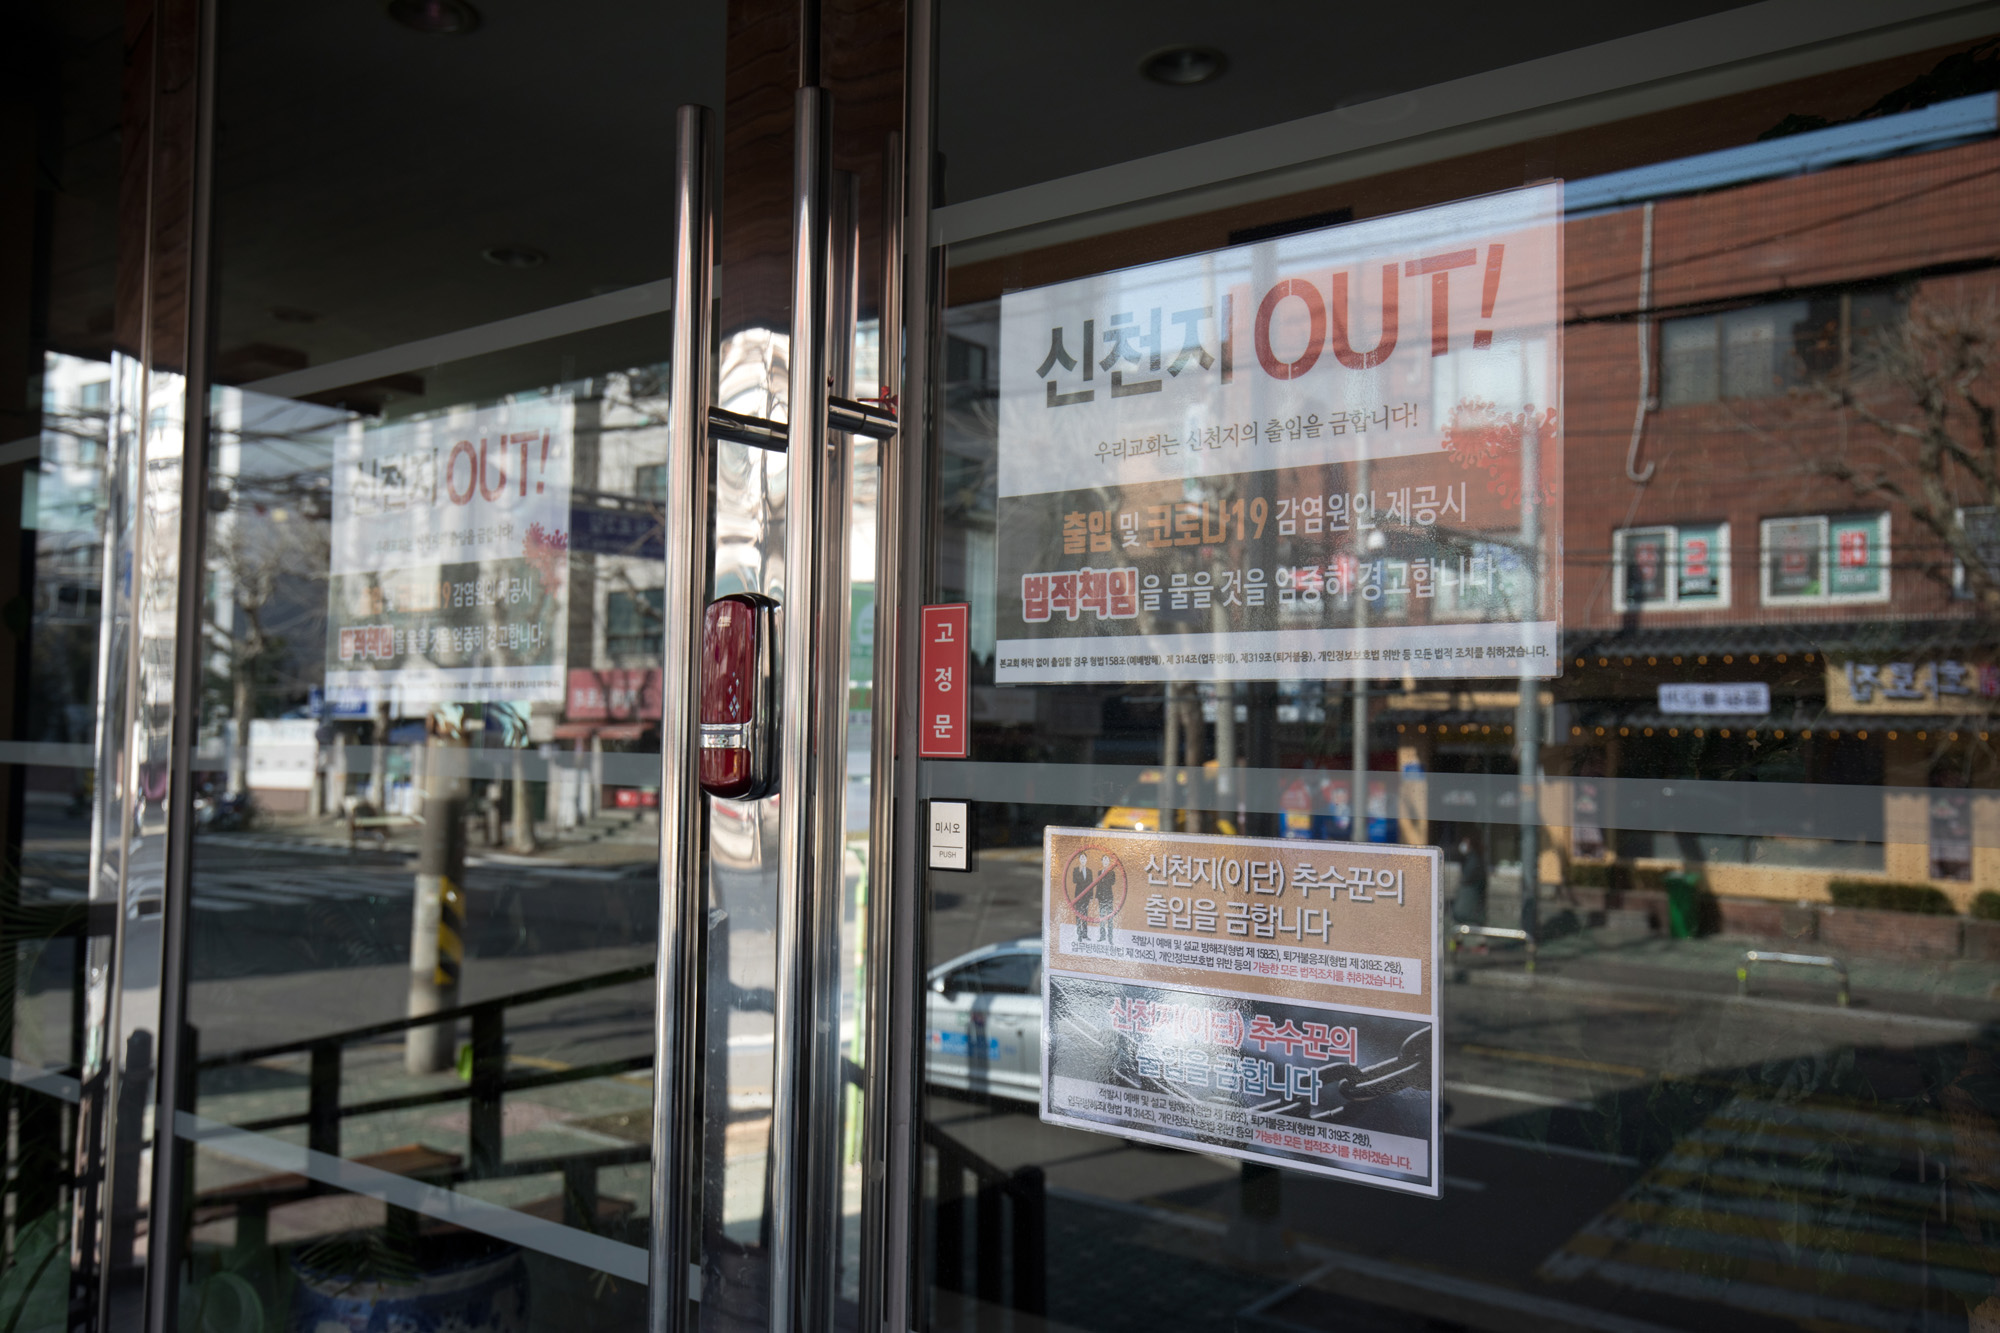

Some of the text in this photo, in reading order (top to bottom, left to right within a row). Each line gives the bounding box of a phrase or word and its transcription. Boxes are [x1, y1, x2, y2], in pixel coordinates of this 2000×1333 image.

[1036, 243, 1505, 408] 신천지 OUT!
[1094, 403, 1418, 464] 우리교회는 신천지의 출입을 금합니다!
[447, 428, 550, 506] OUT!
[1063, 482, 1466, 554] 출입 및 코로나19 감염원인 제공시
[1022, 567, 1162, 623] 법적책임을
[1168, 571, 1214, 610] 물을
[1221, 568, 1267, 607] 것을
[1275, 562, 1348, 605] 엄중히
[934, 622, 955, 739] 고정문
[1074, 656, 1088, 667] 경우
[1166, 654, 1174, 665] 제
[1382, 649, 1400, 661] 위반
[1402, 648, 1411, 660] 등
[1434, 647, 1453, 660] 법적
[935, 821, 960, 834] 미시오
[939, 850, 957, 859] PUSH
[1143, 854, 1405, 904] 신천지(이단) 추수꾼의
[1143, 894, 1332, 943] 출입을 금합니다
[1131, 935, 1155, 947] 적발시
[1156, 937, 1172, 949] 예배
[1173, 939, 1182, 950] 및
[1183, 940, 1199, 951] 설교
[1246, 947, 1255, 958] 제
[1349, 957, 1359, 970] 제
[1159, 951, 1214, 968] 개인정보보호법
[1216, 957, 1233, 970] 위반
[1234, 959, 1251, 972] 등의
[1253, 961, 1279, 975] 가능한
[1280, 964, 1298, 977] 모든
[1300, 967, 1344, 983] 법적조치를
[1346, 971, 1405, 989] 취하겠습니다.
[1249, 1013, 1359, 1066] 추수꾼의
[1213, 1053, 1323, 1106] 금합니다
[1124, 1092, 1140, 1104] 예배
[1141, 1094, 1149, 1106] 및
[1150, 1097, 1167, 1109] 설교
[1317, 1127, 1327, 1139] 제
[1255, 1129, 1282, 1145] 가능한
[1283, 1134, 1302, 1148] 모든
[1303, 1138, 1349, 1158] 법적조치를
[1352, 1147, 1412, 1170] 취하겠습니다.
